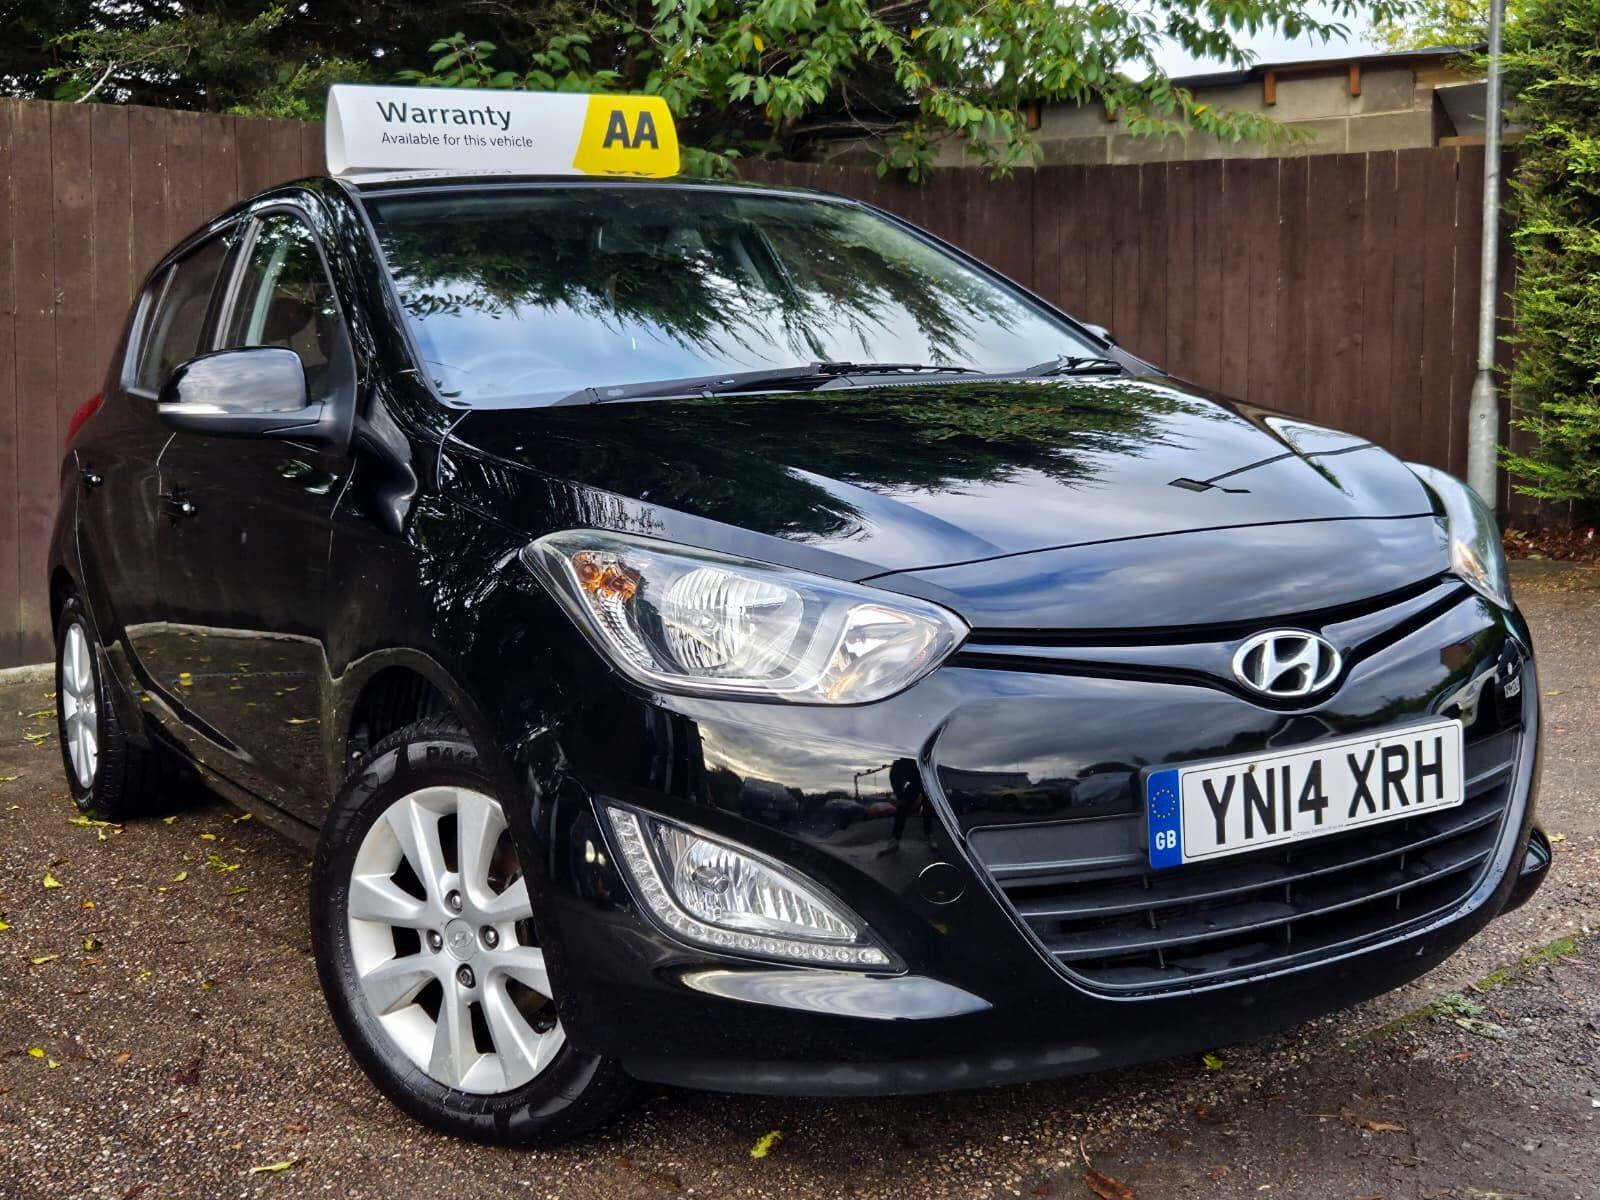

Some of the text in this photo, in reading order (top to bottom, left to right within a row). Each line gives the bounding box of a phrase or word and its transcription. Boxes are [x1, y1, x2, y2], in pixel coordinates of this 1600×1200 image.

[377, 101, 511, 131] Warranty
[603, 110, 659, 149] AA
[381, 132, 533, 148] Available for this vehicle
[1203, 736, 1444, 845] YN14 XRH
[1155, 830, 1177, 850] GB
